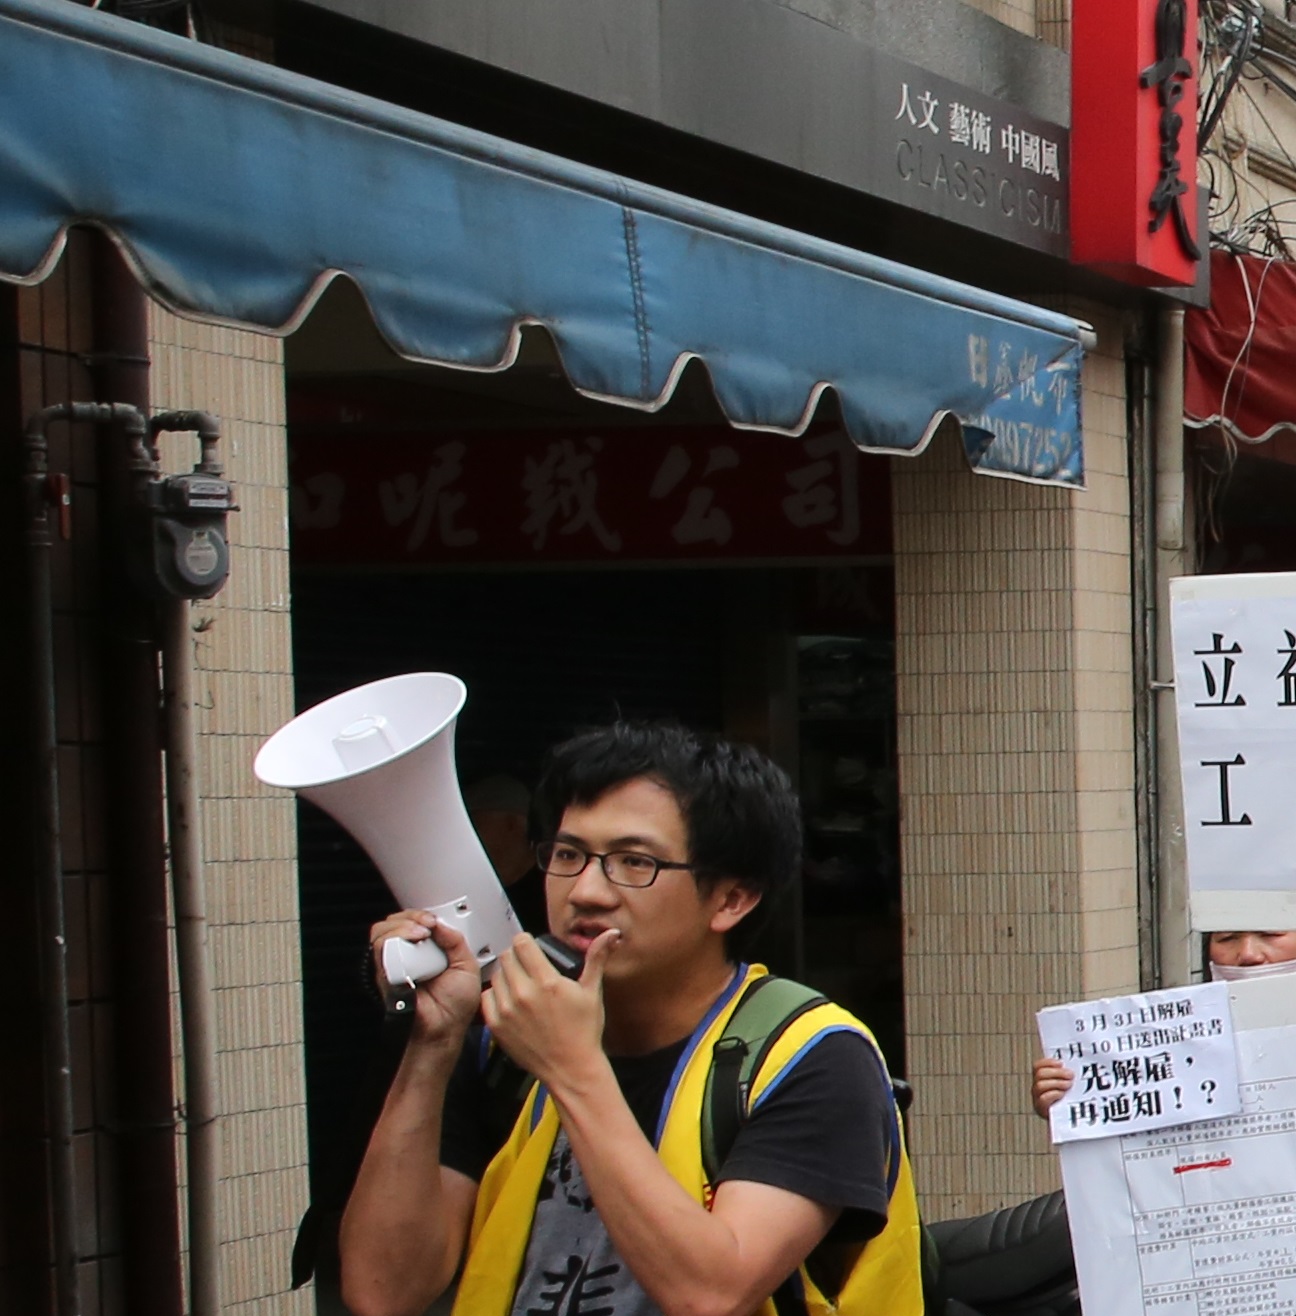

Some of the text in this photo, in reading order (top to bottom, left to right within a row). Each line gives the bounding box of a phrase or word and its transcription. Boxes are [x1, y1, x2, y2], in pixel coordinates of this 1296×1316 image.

[896, 83, 1060, 181] 人文 藝術 中國風
